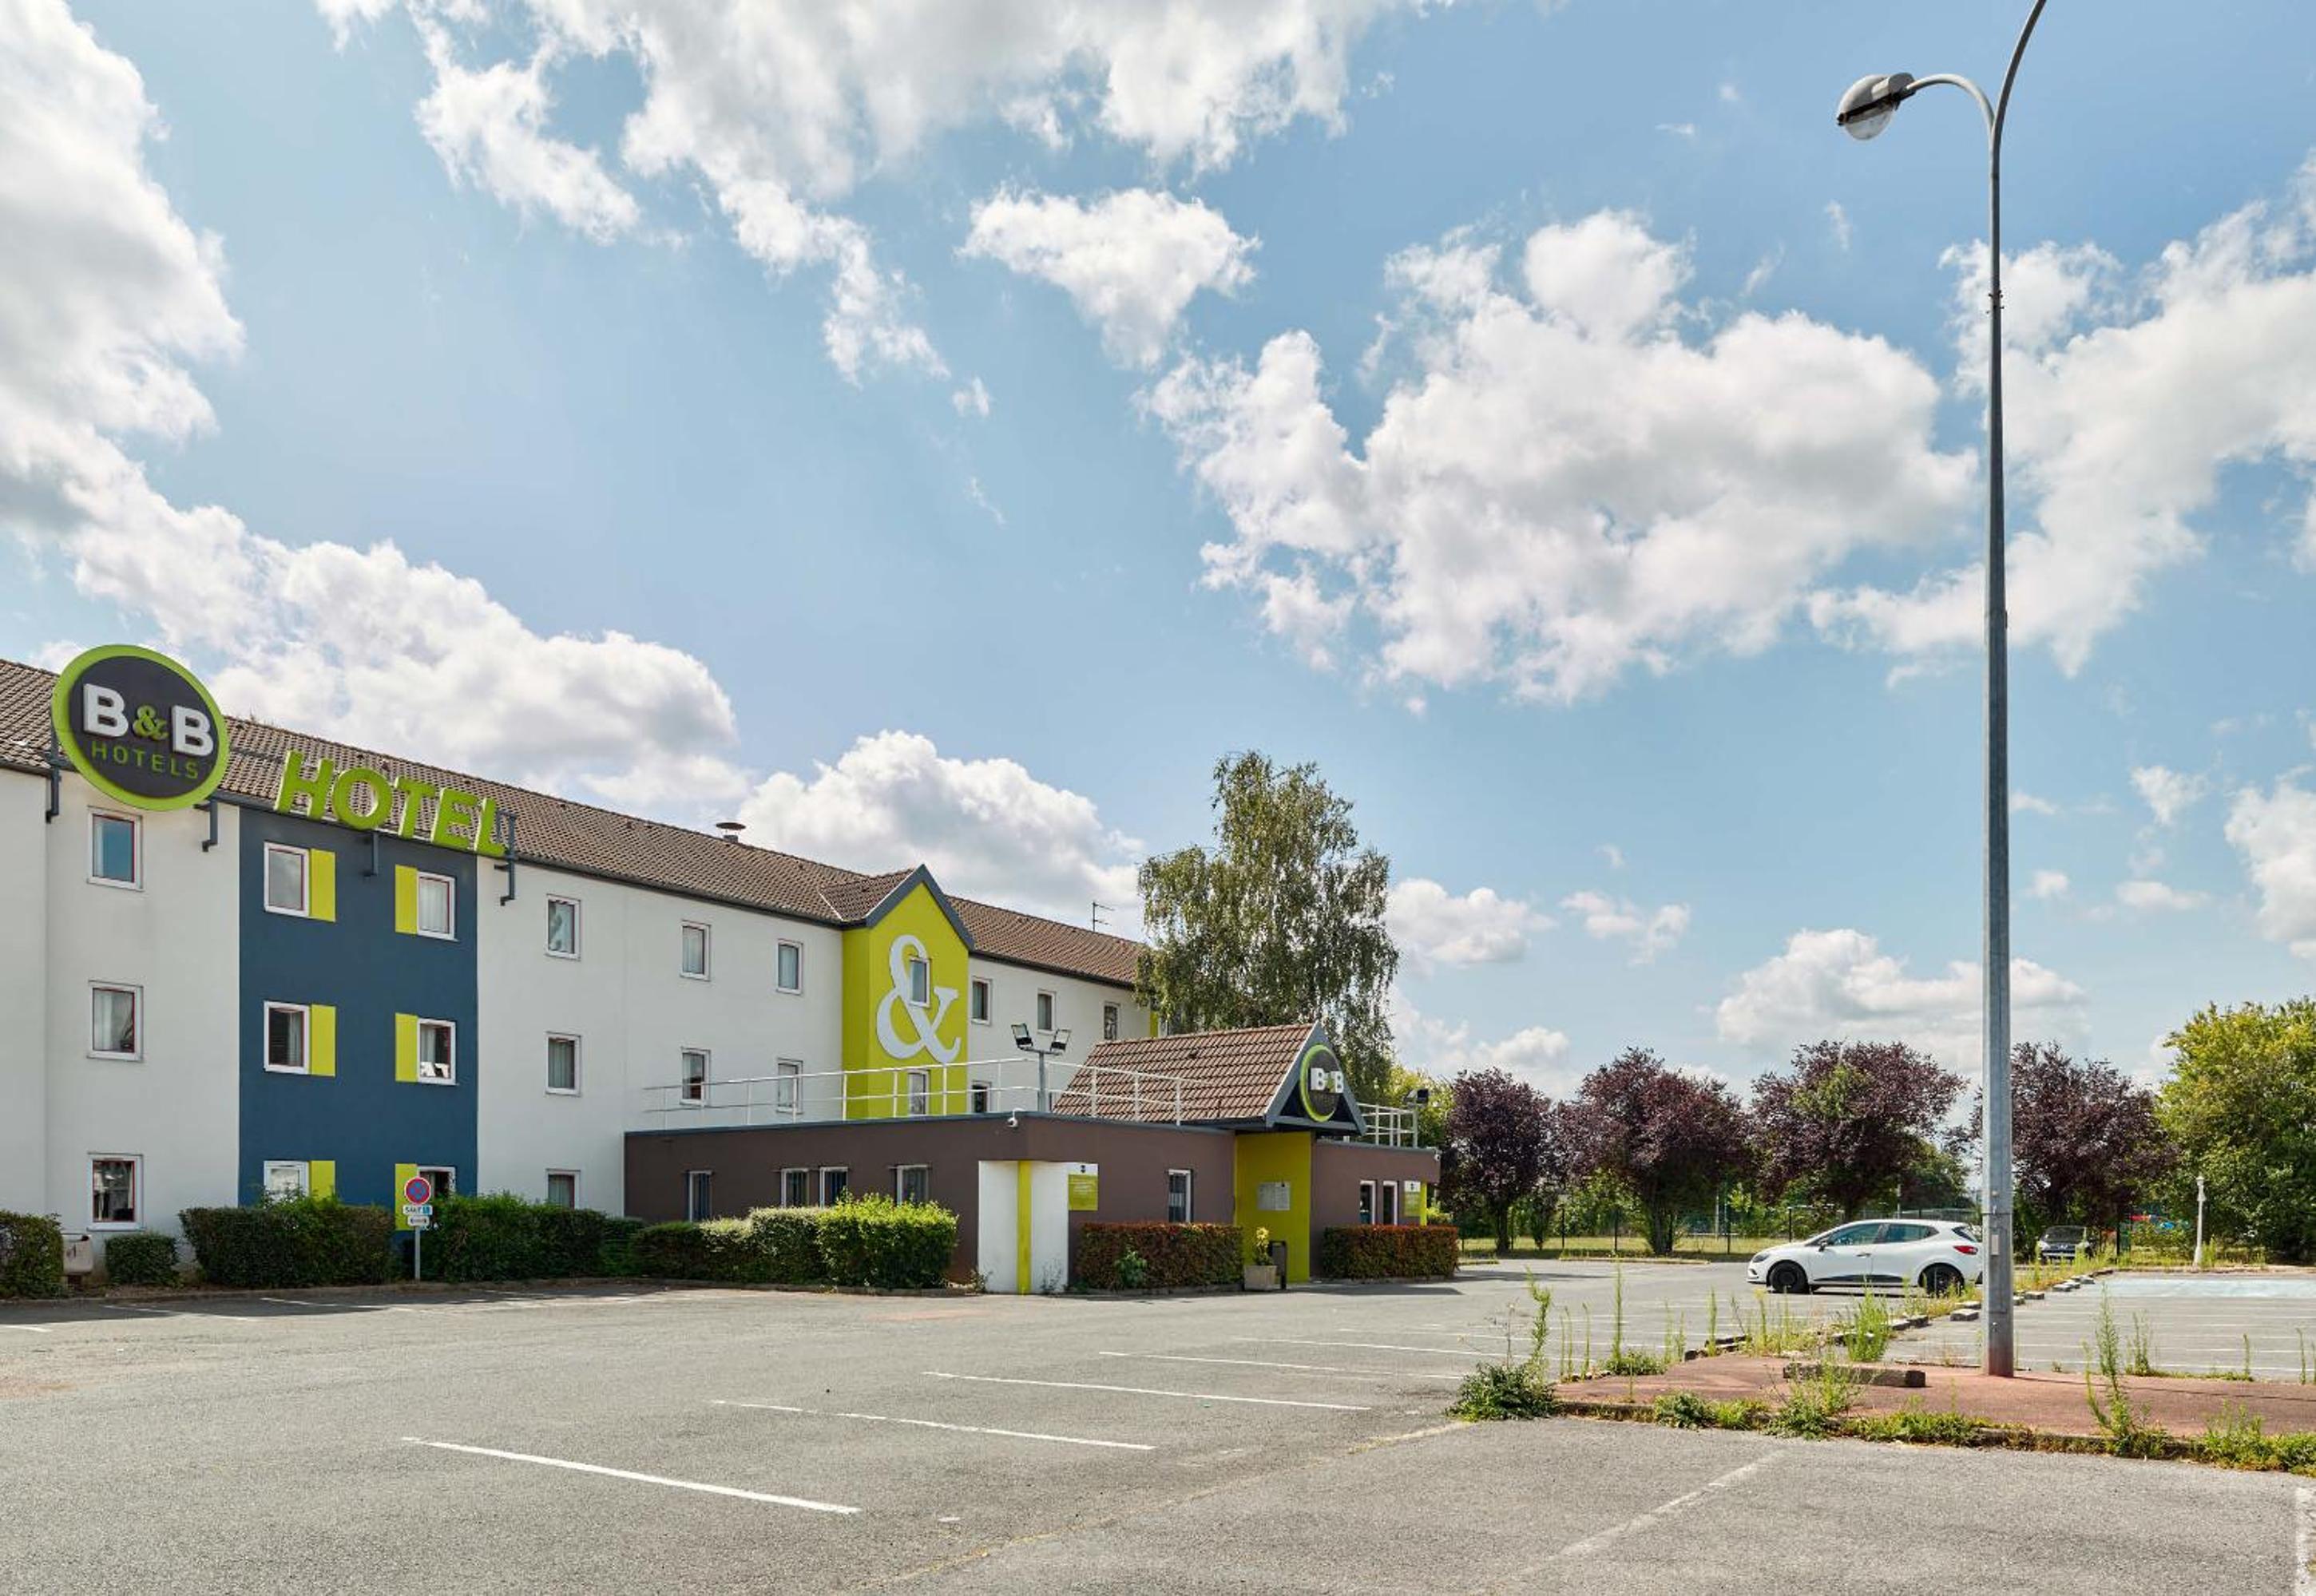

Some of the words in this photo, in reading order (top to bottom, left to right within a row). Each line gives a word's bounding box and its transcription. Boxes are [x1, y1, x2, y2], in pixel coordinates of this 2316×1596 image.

[82, 683, 214, 757] B&B
[90, 740, 199, 780] HOTELS
[273, 749, 506, 857] HOTEL
